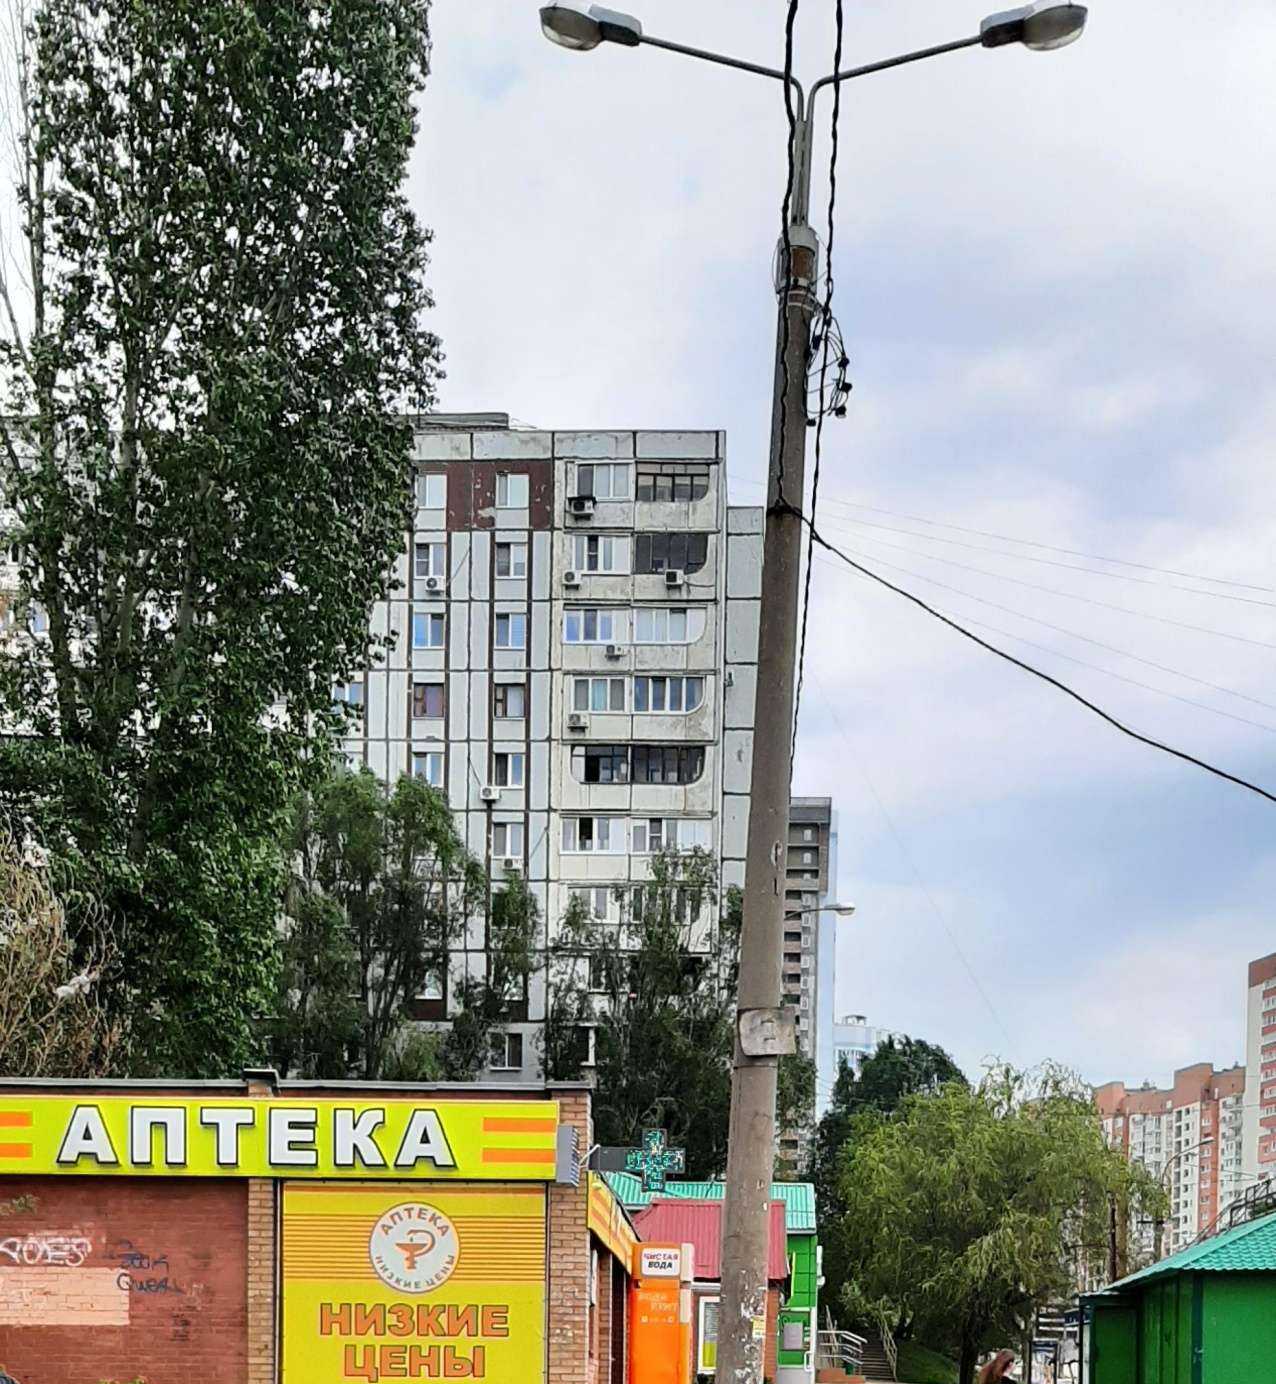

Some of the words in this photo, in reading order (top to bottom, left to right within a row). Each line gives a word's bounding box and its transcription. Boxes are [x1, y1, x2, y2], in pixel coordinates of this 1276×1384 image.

[56, 1104, 457, 1168] АПТЕКА
[380, 1207, 449, 1236] АПТЕКА
[375, 1255, 422, 1289] НИЗКИЕ
[426, 1254, 455, 1287] ЦЕНЫ
[648, 1261, 673, 1270] ВОДА
[320, 1302, 509, 1337] НИЗКИЕ
[344, 1344, 485, 1383] ЦЕНЫ
